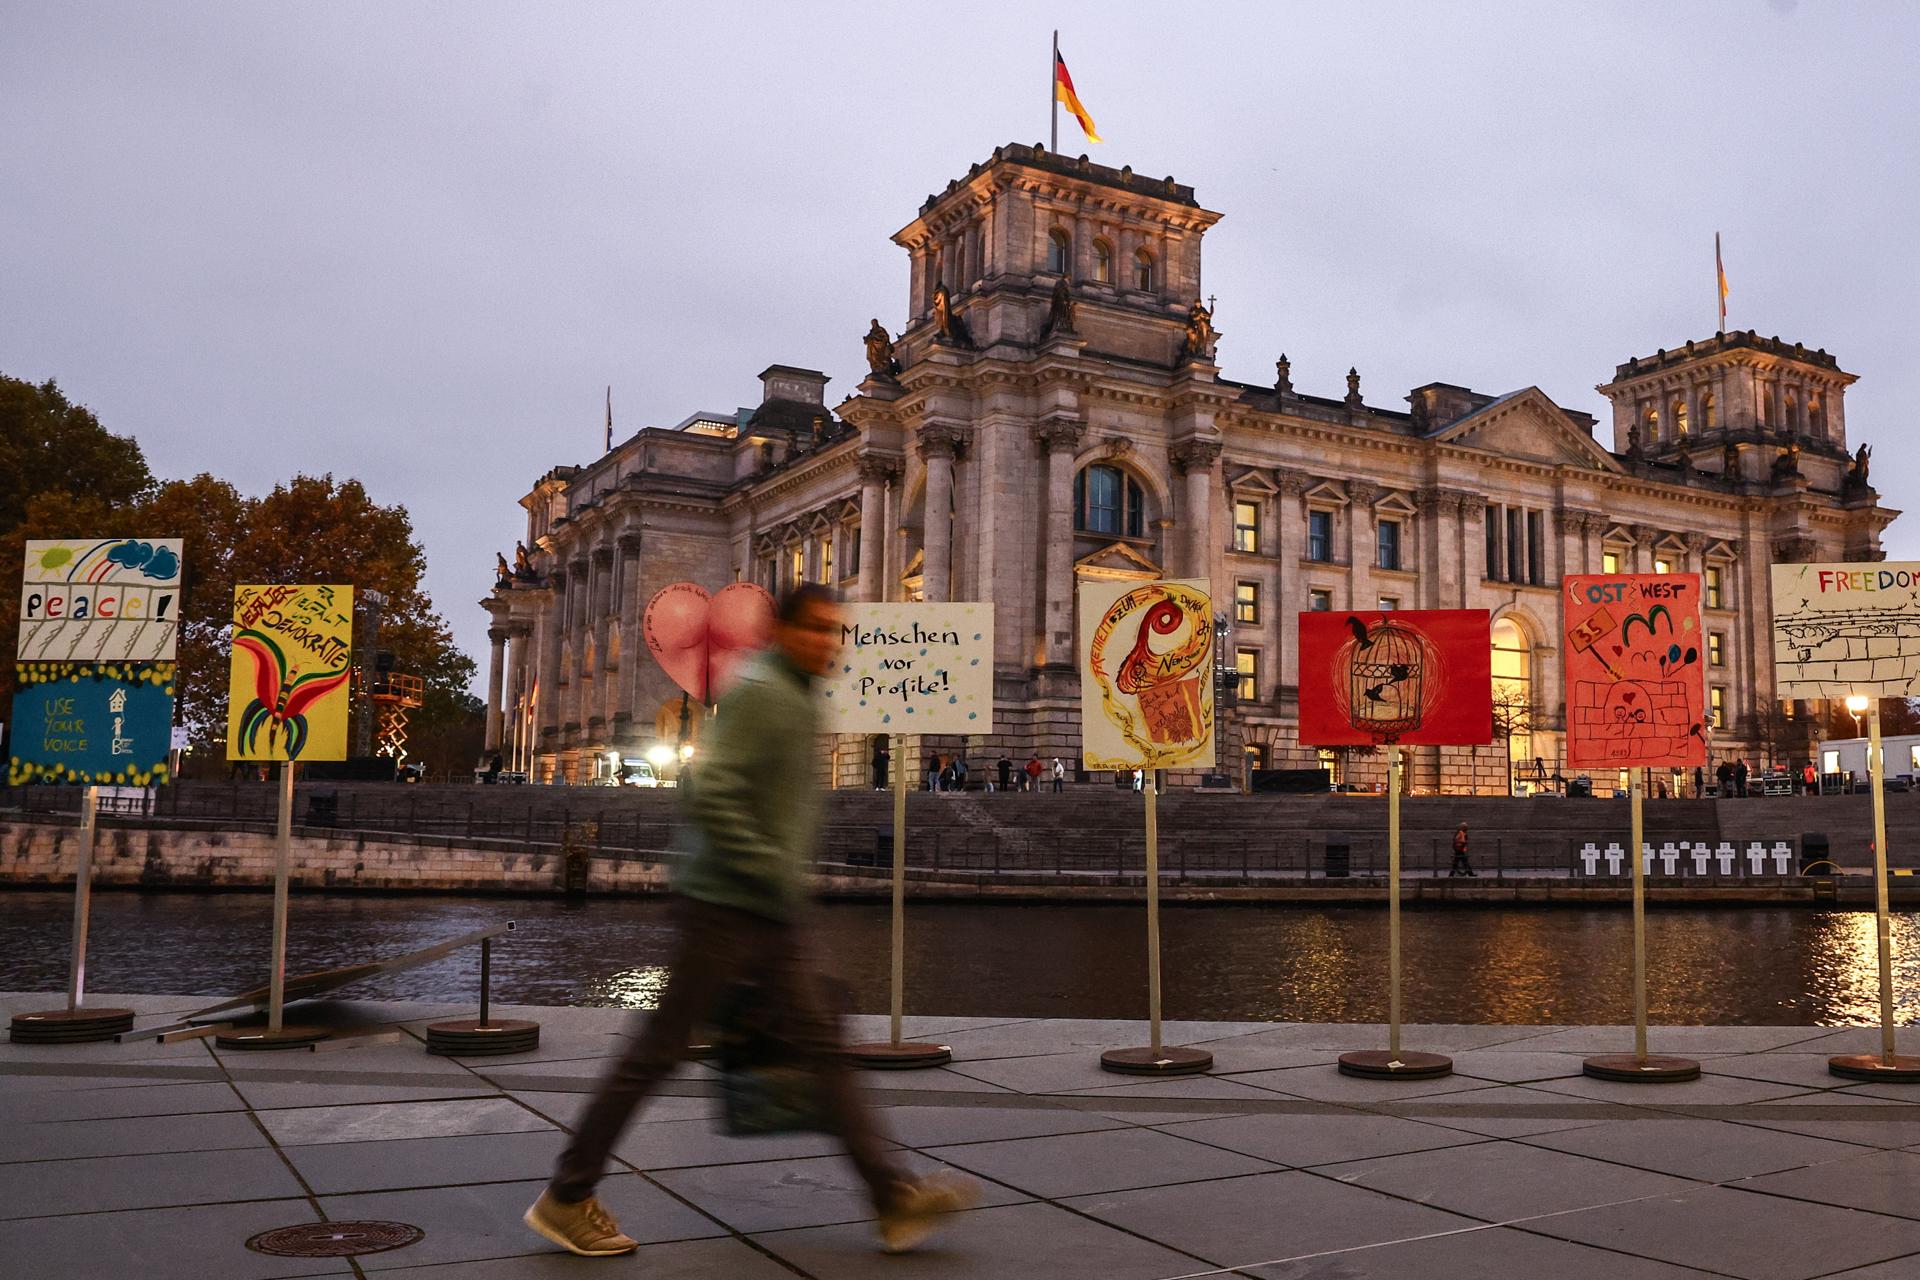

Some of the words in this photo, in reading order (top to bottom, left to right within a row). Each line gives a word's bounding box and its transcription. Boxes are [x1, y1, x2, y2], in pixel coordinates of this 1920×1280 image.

[1586, 583, 1628, 604] OST
[1640, 582, 1686, 599] WEST
[261, 610, 348, 668] DEMOKRATIE
[841, 623, 960, 645] Menschen
[884, 658, 916, 670] vor
[859, 671, 949, 702] Profite!
[45, 698, 75, 715] USE
[44, 717, 85, 735] YOUR
[44, 738, 88, 751] VOICE
